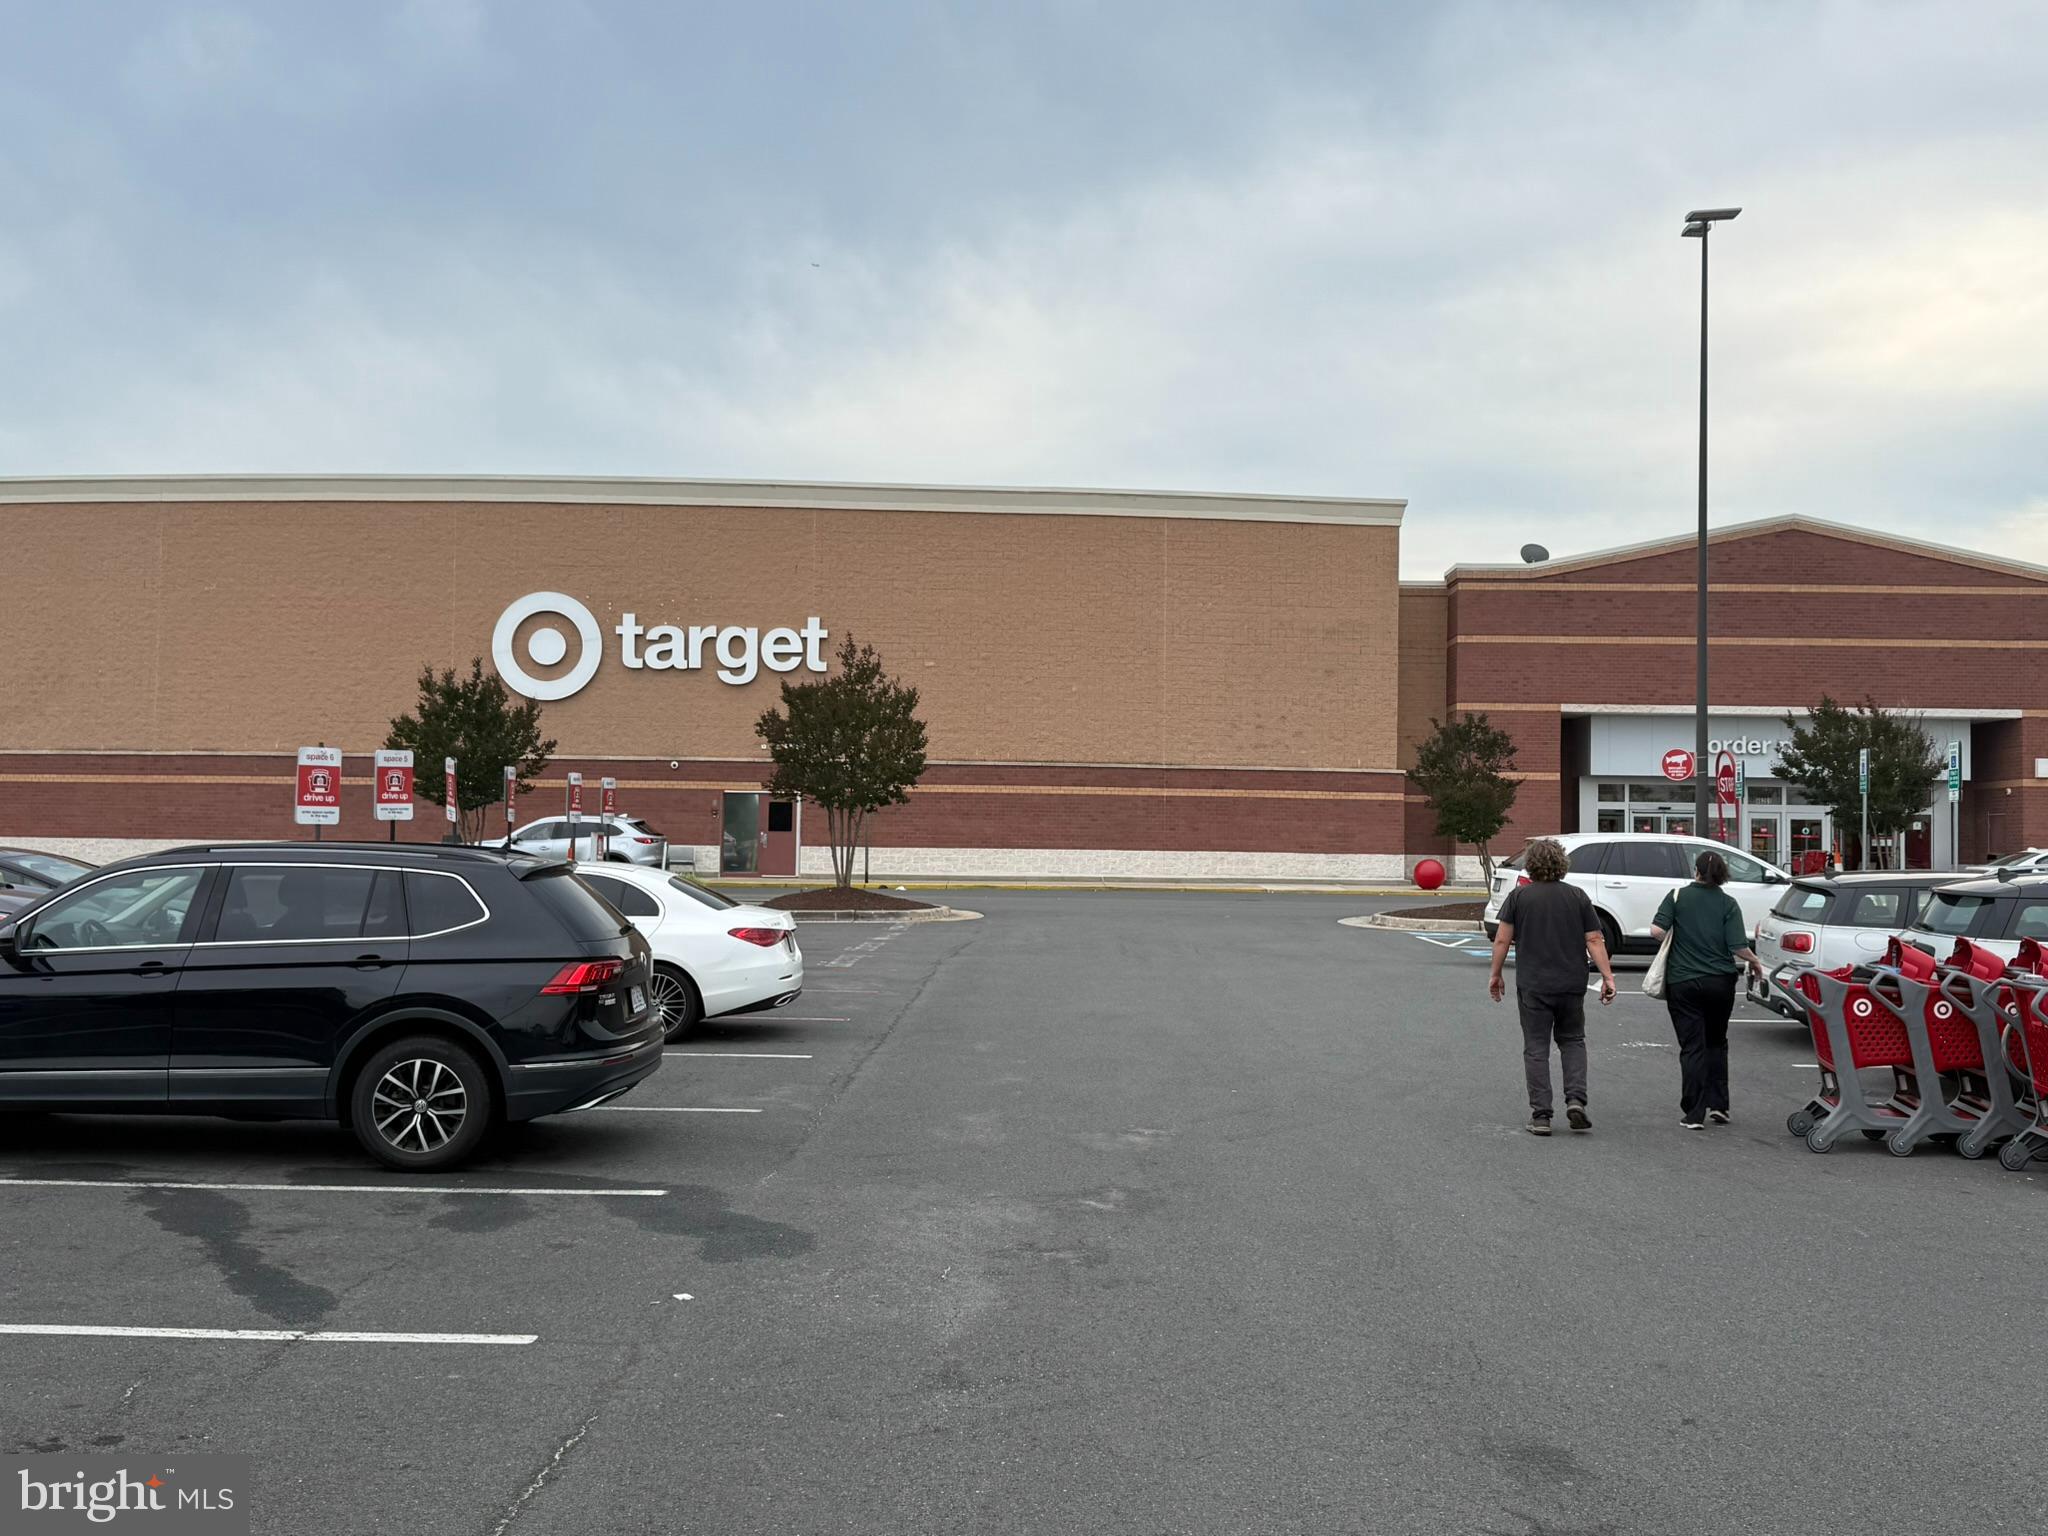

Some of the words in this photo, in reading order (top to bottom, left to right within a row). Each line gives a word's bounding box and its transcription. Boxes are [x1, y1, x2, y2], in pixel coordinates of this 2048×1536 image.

[615, 613, 828, 685] target
[1708, 736, 1771, 754] order
[303, 794, 324, 802] drive
[325, 795, 335, 803] up
[381, 792, 398, 800] drive
[400, 793, 408, 801] up
